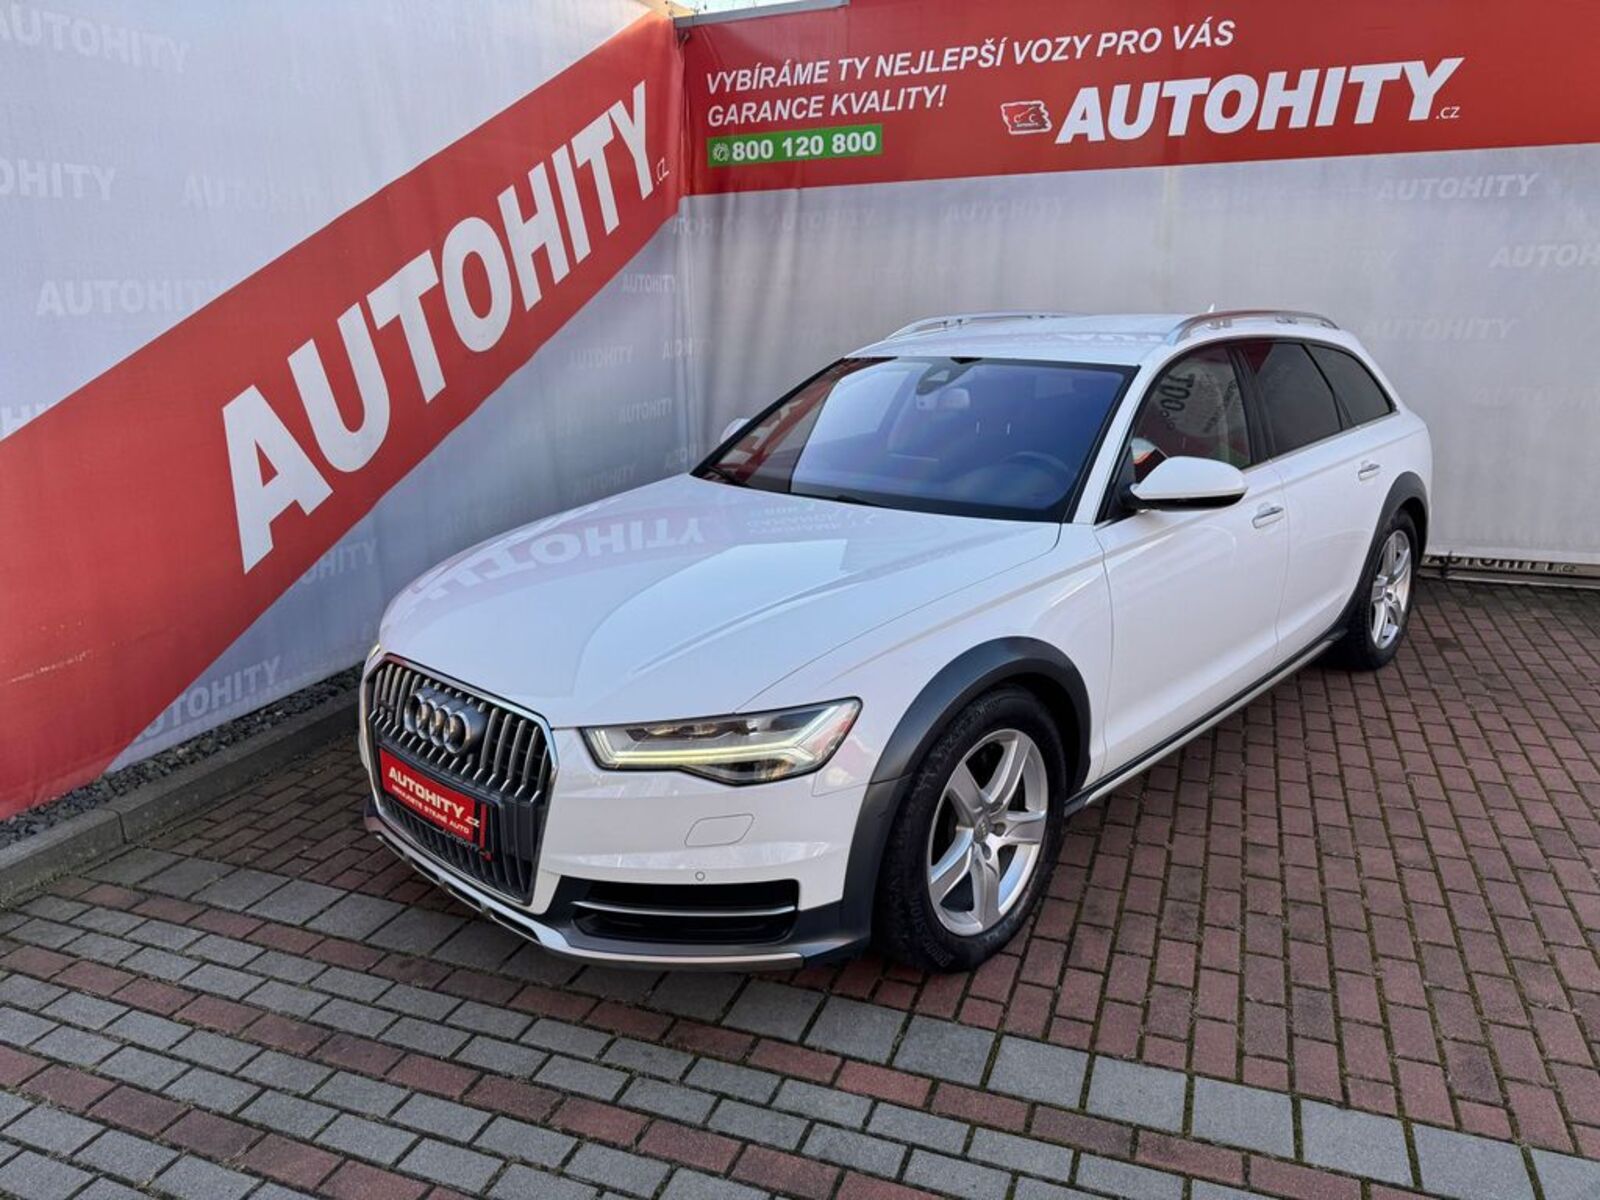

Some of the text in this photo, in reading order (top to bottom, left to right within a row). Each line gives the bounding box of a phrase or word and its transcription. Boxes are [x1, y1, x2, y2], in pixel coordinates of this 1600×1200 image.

[706, 16, 1236, 95] VYBÍRÁME TY NEJLEPŠÍ VOZY PRO VÁS
[707, 85, 948, 127] GARANCE KVALITY!
[731, 130, 877, 162] 800 120 800
[1373, 172, 1540, 202] AUTOHITY
[388, 766, 465, 819] AUTOHITY
